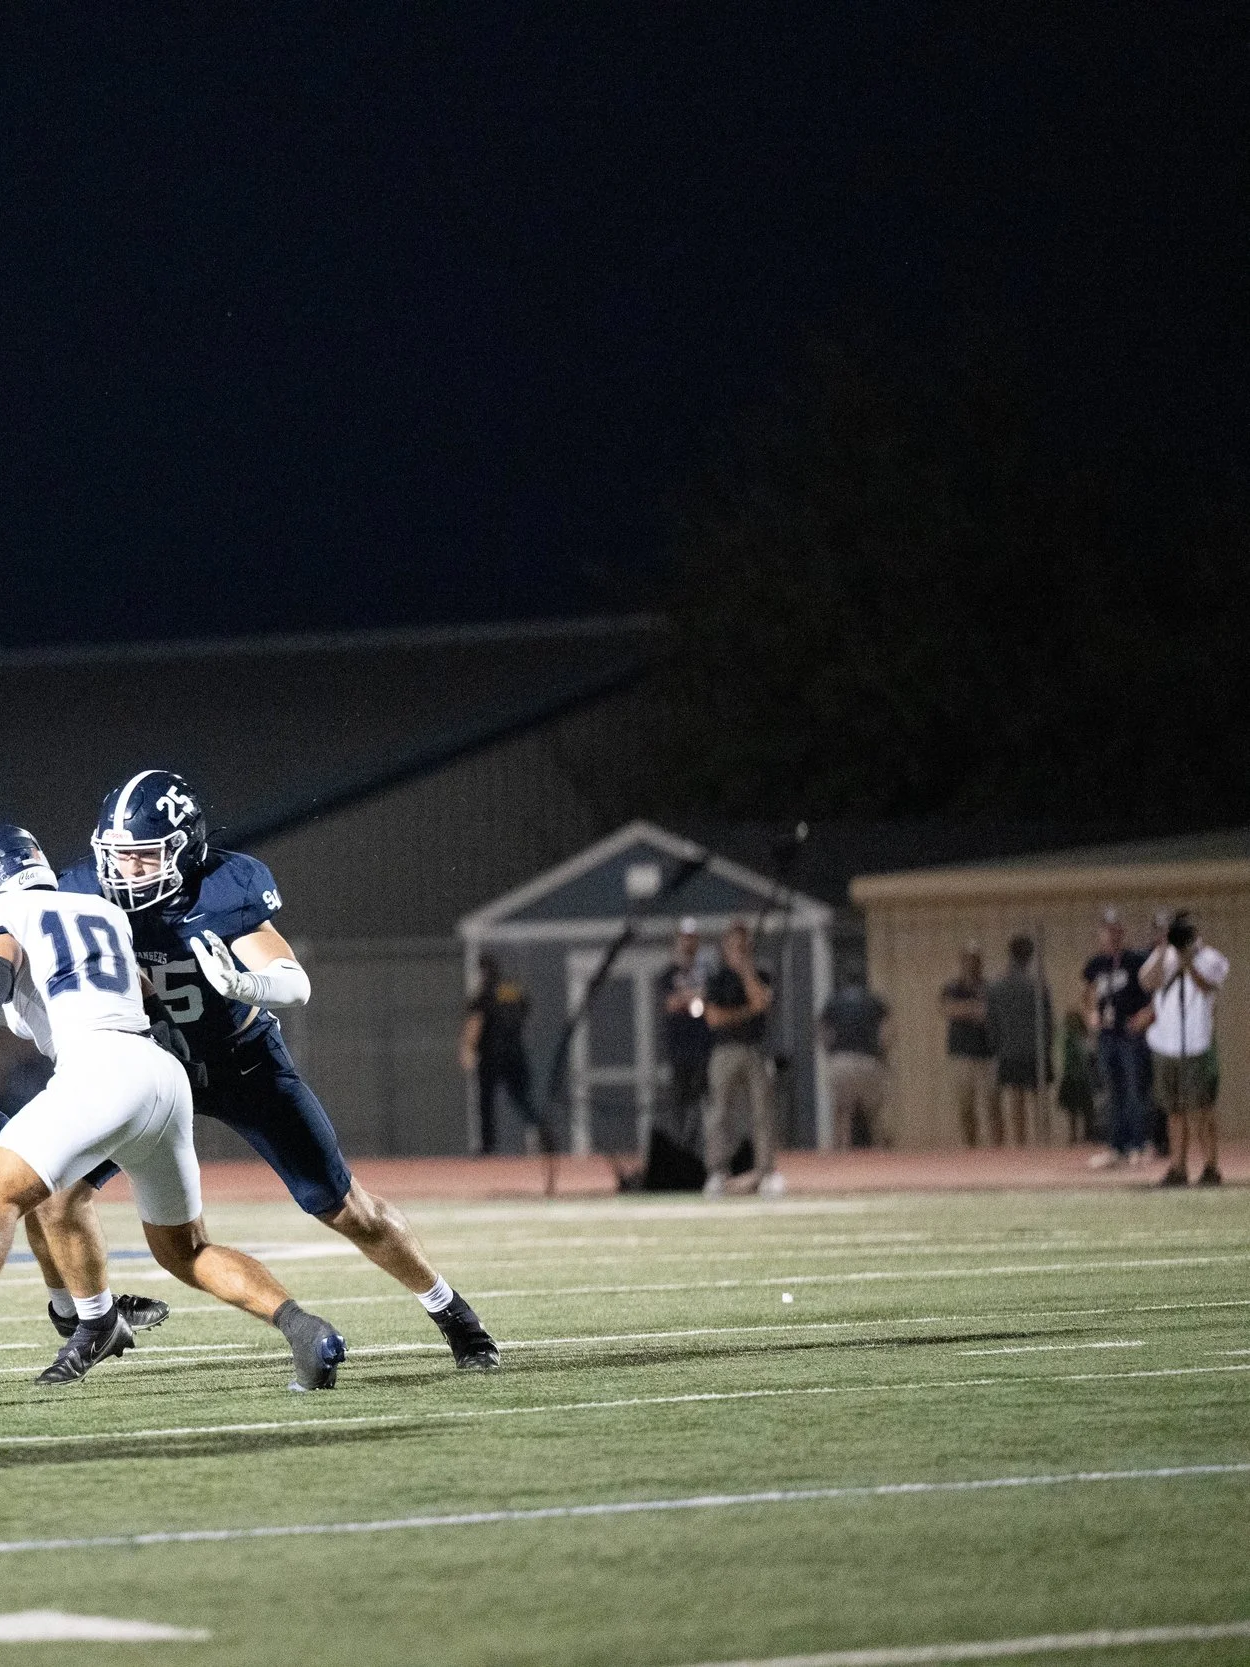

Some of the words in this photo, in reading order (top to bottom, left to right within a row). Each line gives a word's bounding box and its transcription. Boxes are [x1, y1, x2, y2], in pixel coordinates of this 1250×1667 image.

[156, 785, 194, 828] 25
[38, 909, 132, 999] 10
[139, 957, 204, 1024] 5
